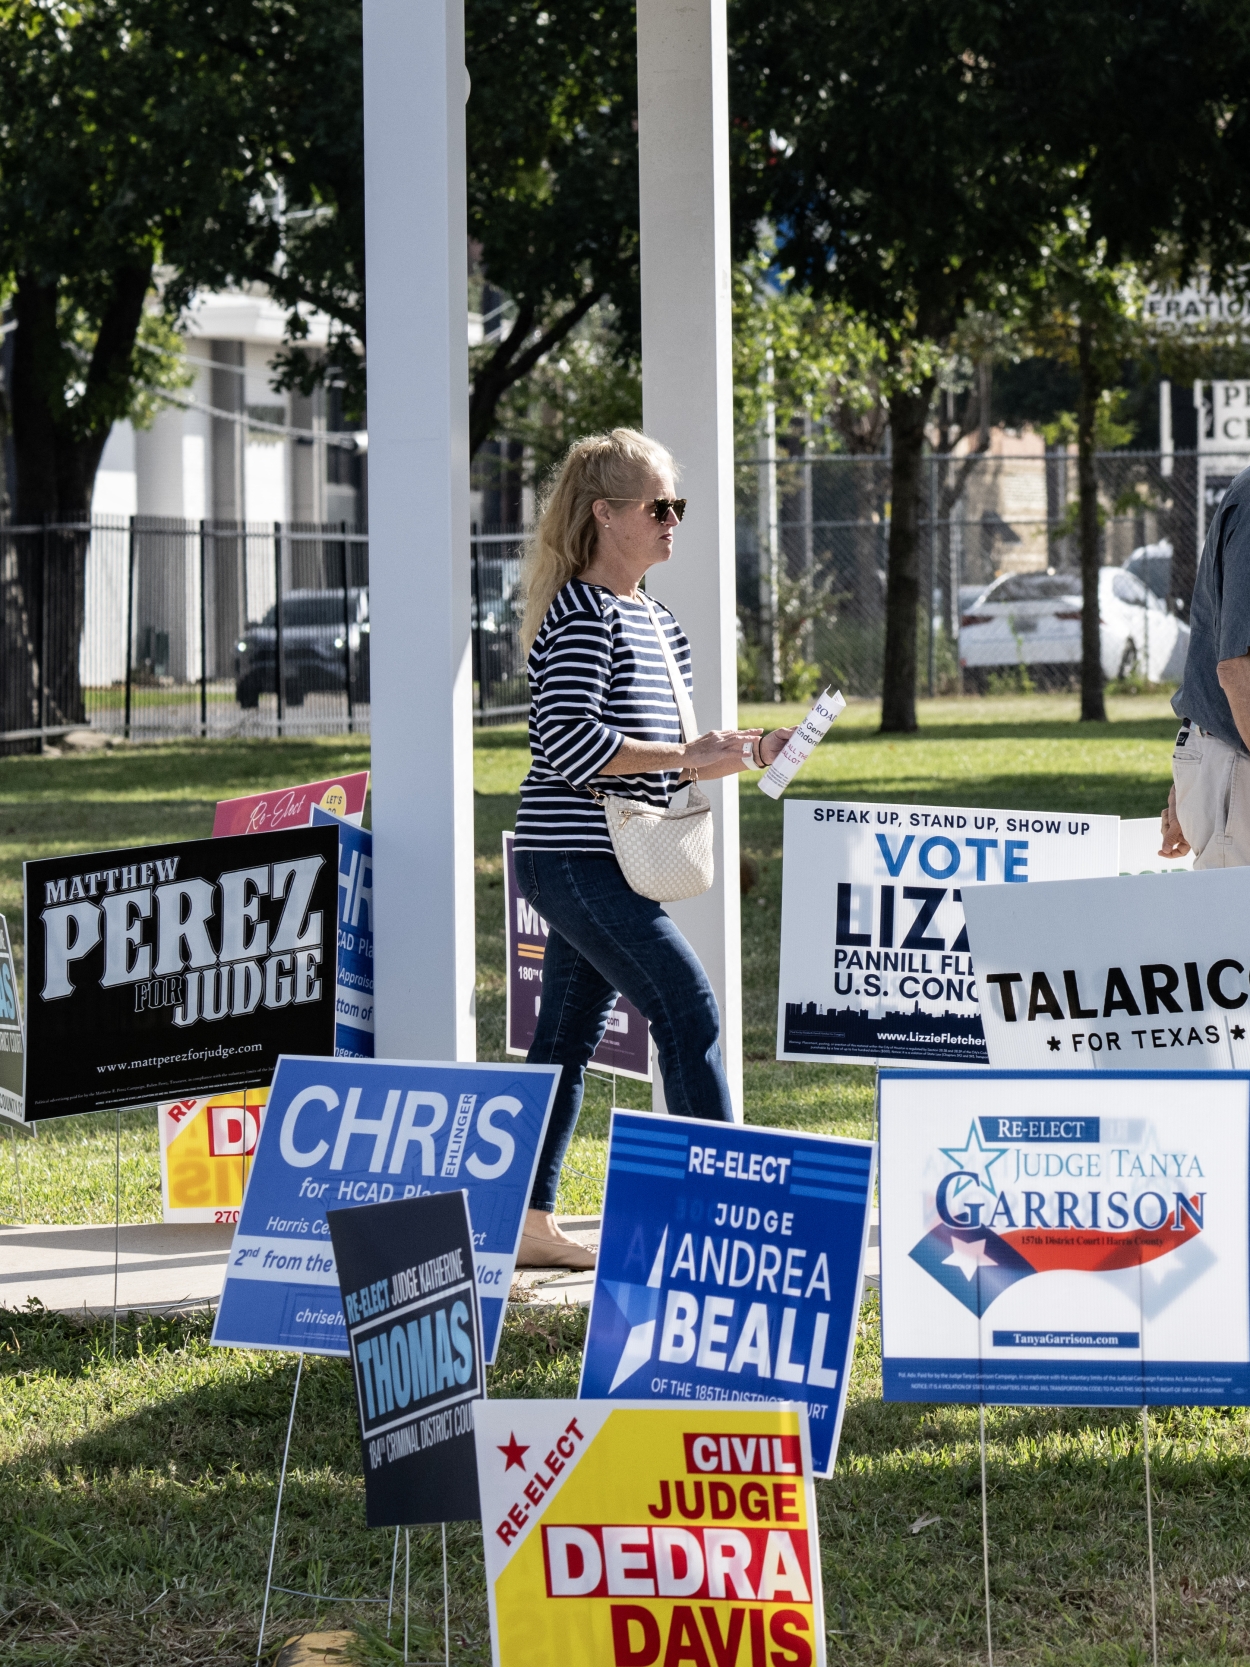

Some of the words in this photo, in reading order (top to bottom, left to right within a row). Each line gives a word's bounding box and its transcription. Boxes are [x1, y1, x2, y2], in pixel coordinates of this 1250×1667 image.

[326, 794, 342, 805] LET'S
[813, 807, 870, 824] SPEAK
[877, 811, 903, 828] UP,
[909, 812, 967, 829] STAND
[974, 816, 1000, 833] UP,
[1006, 817, 1062, 835] SHOW
[1068, 821, 1091, 836] UP
[874, 833, 1029, 883] VOTE
[45, 855, 181, 906] MATTHEW
[39, 854, 327, 1002] PEREZ
[834, 949, 933, 975] PANNILL
[134, 976, 183, 1013] FOR
[172, 947, 324, 1029] JUDGE
[834, 971, 889, 997] U.S.
[96, 1042, 264, 1074] www.mattperezforjudge.com
[1072, 1031, 1122, 1053] FOR
[1132, 1024, 1221, 1050] TEXAS
[279, 1084, 524, 1181] CHRIS
[441, 1094, 477, 1179] EHLINGER
[998, 1118, 1086, 1139] RE-ELECT
[688, 1145, 791, 1186] RE-ELECT
[298, 1177, 329, 1199] for
[337, 1180, 394, 1203] HCAD
[934, 1170, 1208, 1232] GARRISON
[266, 1216, 308, 1235] Harris
[714, 1203, 794, 1236] JUDGE
[234, 1246, 262, 1267] 2nd
[262, 1250, 302, 1271] from
[307, 1253, 333, 1273] the
[1021, 1235, 1043, 1245] 157th
[1045, 1236, 1075, 1246] District
[1076, 1236, 1099, 1246] Court
[1106, 1236, 1133, 1246] Harris
[1134, 1237, 1164, 1248] County
[345, 1277, 389, 1325] RE-ELECT
[391, 1266, 421, 1306] JUDGE
[418, 1247, 465, 1292] KATHERINE
[670, 1232, 832, 1302] ANDREA
[658, 1288, 839, 1389] BEALL
[1012, 1332, 1119, 1347] TanyaGarrison.com
[357, 1300, 474, 1421] THOMAS
[651, 1377, 668, 1393] OF
[669, 1380, 693, 1398] THE
[695, 1384, 729, 1402] 185TH
[368, 1438, 386, 1470] 184TH
[385, 1423, 421, 1464] CRIMINAL
[420, 1408, 453, 1449] DISTRICT
[692, 1436, 797, 1474] CIVIL
[494, 1416, 586, 1547] RE-ELECT
[647, 1480, 800, 1523] JUDGE
[545, 1526, 812, 1603] DEDRA
[610, 1604, 813, 1667] DAVIS
